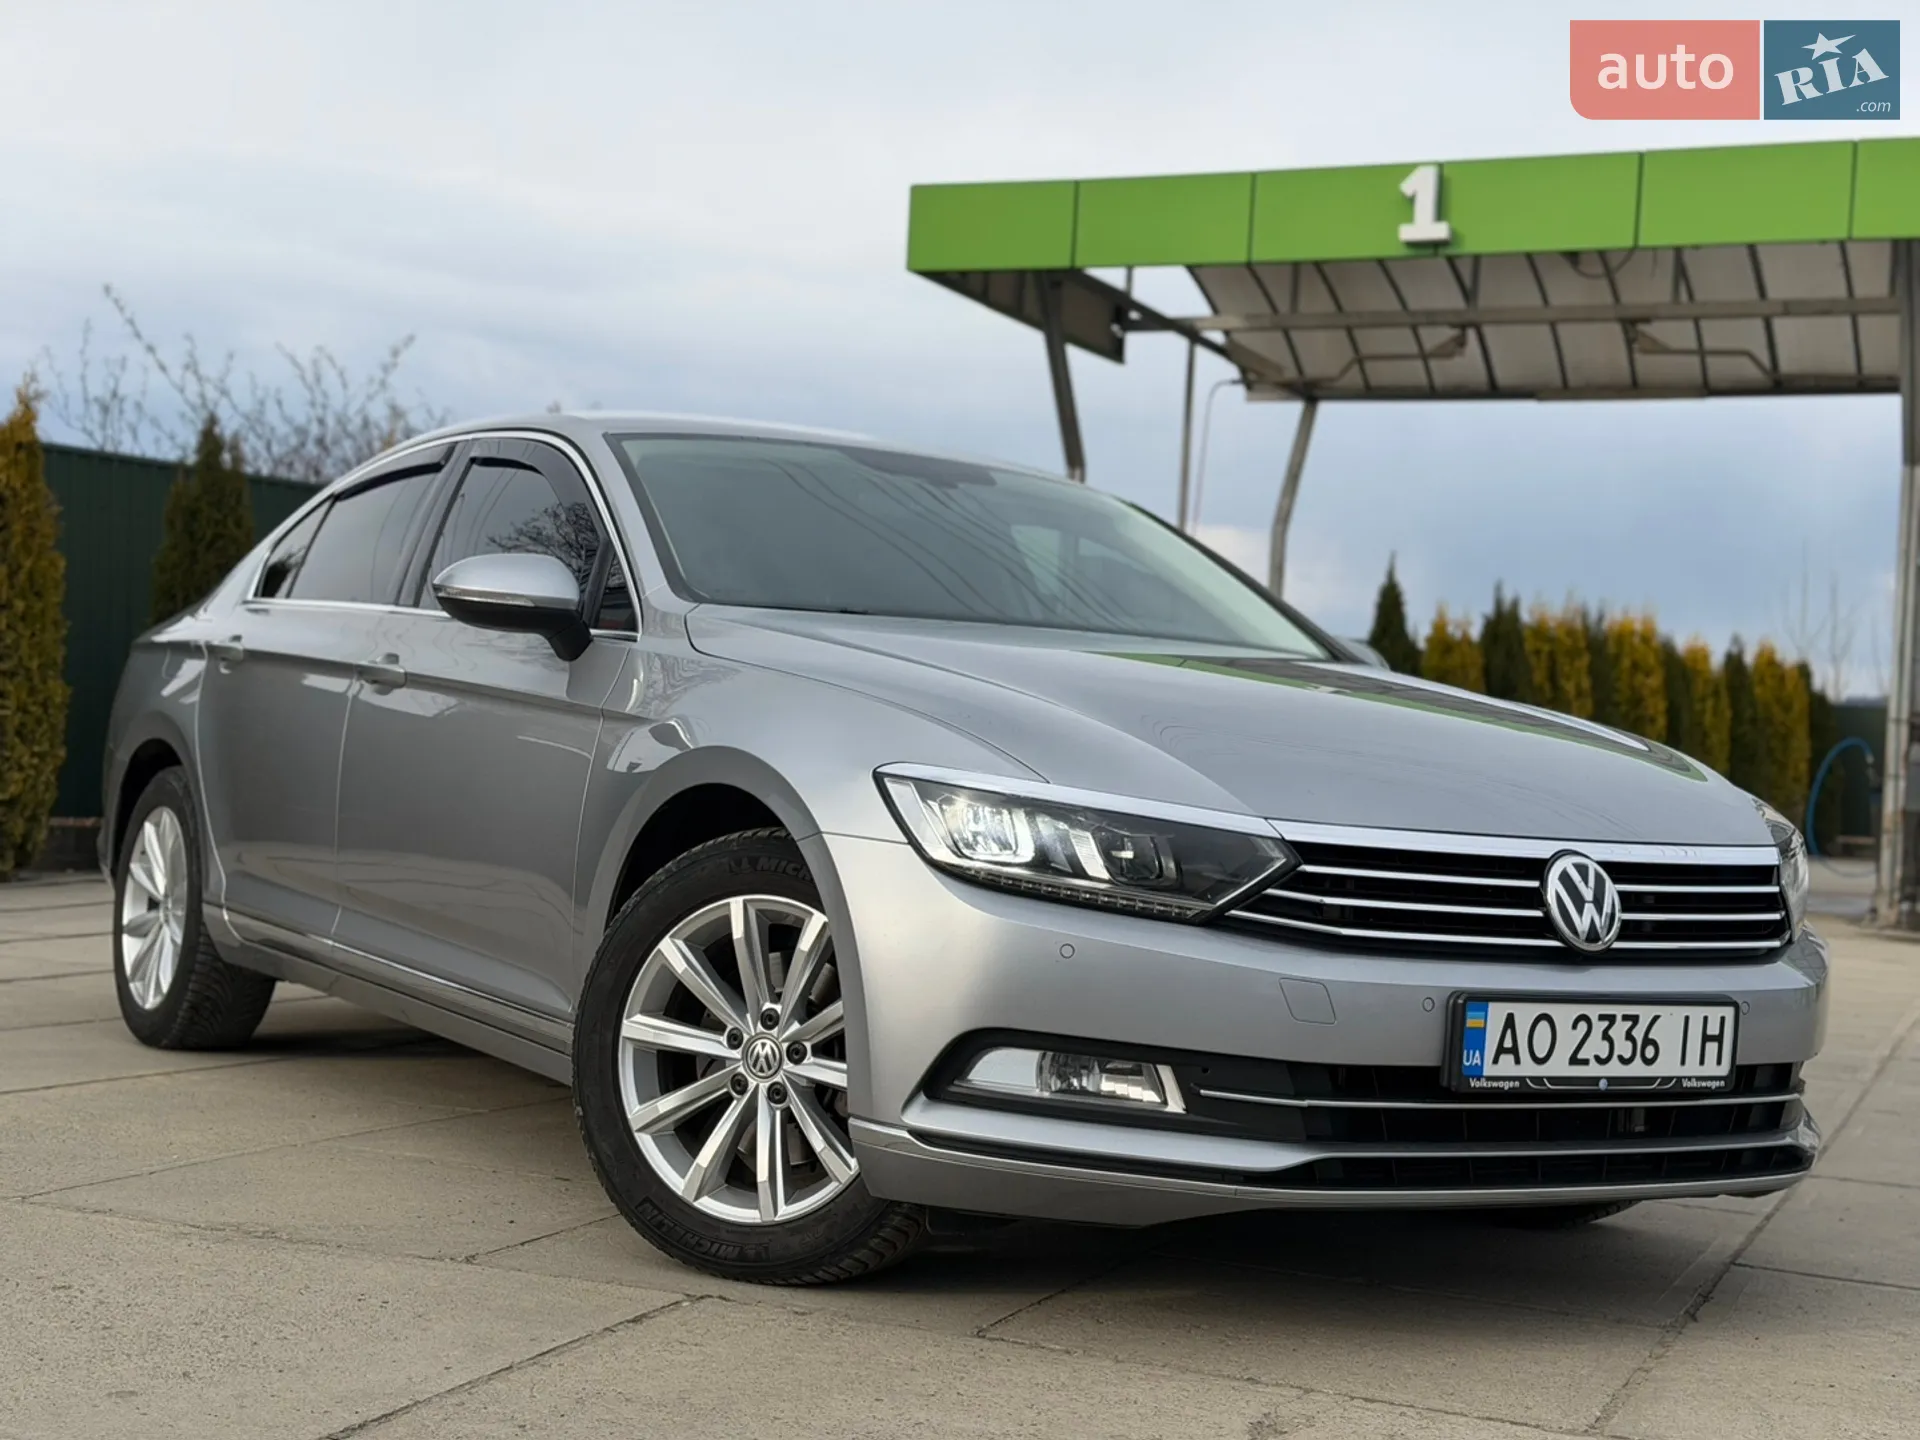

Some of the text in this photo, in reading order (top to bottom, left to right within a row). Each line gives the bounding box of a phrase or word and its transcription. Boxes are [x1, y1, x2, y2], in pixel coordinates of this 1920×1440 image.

[1398, 164, 1450, 243] 1
[1492, 1012, 1726, 1066] AO 2336 IH
[1463, 1049, 1481, 1066] UA
[1469, 1078, 1520, 1089] Volkswagen
[1681, 1077, 1726, 1088] Volkswagen
